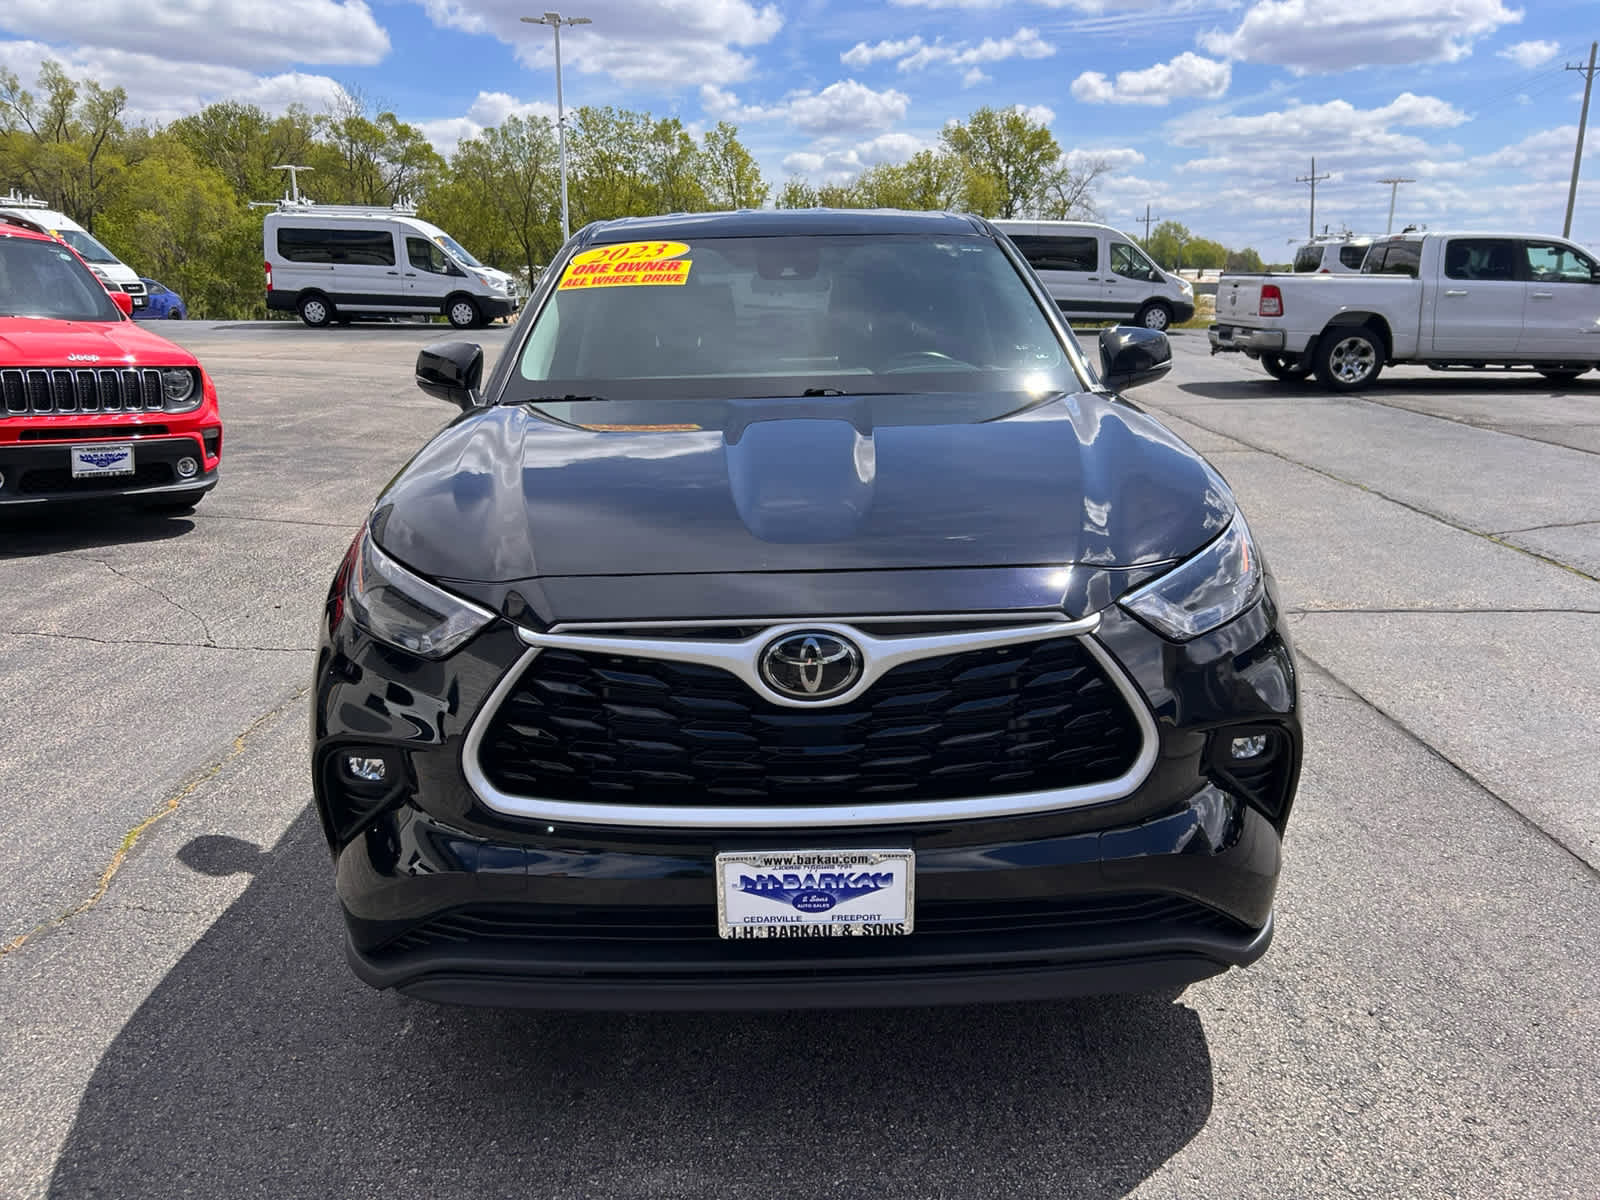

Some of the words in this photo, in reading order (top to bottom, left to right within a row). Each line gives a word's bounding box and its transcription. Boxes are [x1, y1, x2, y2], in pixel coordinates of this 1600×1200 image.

[588, 243, 669, 264] 2023
[572, 264, 611, 275] ONE
[614, 260, 682, 272] OWNER
[562, 278, 588, 288] ALL
[592, 275, 638, 285] WHEEL
[642, 274, 686, 282] DRIVE
[68, 353, 99, 362] Jeep
[763, 854, 868, 866] www.barkau.com
[743, 915, 803, 924] CEDARVILLE
[831, 914, 882, 922] FREEPORT
[767, 924, 833, 938] BARKAU
[842, 923, 853, 937] &
[862, 922, 905, 937] SONS
